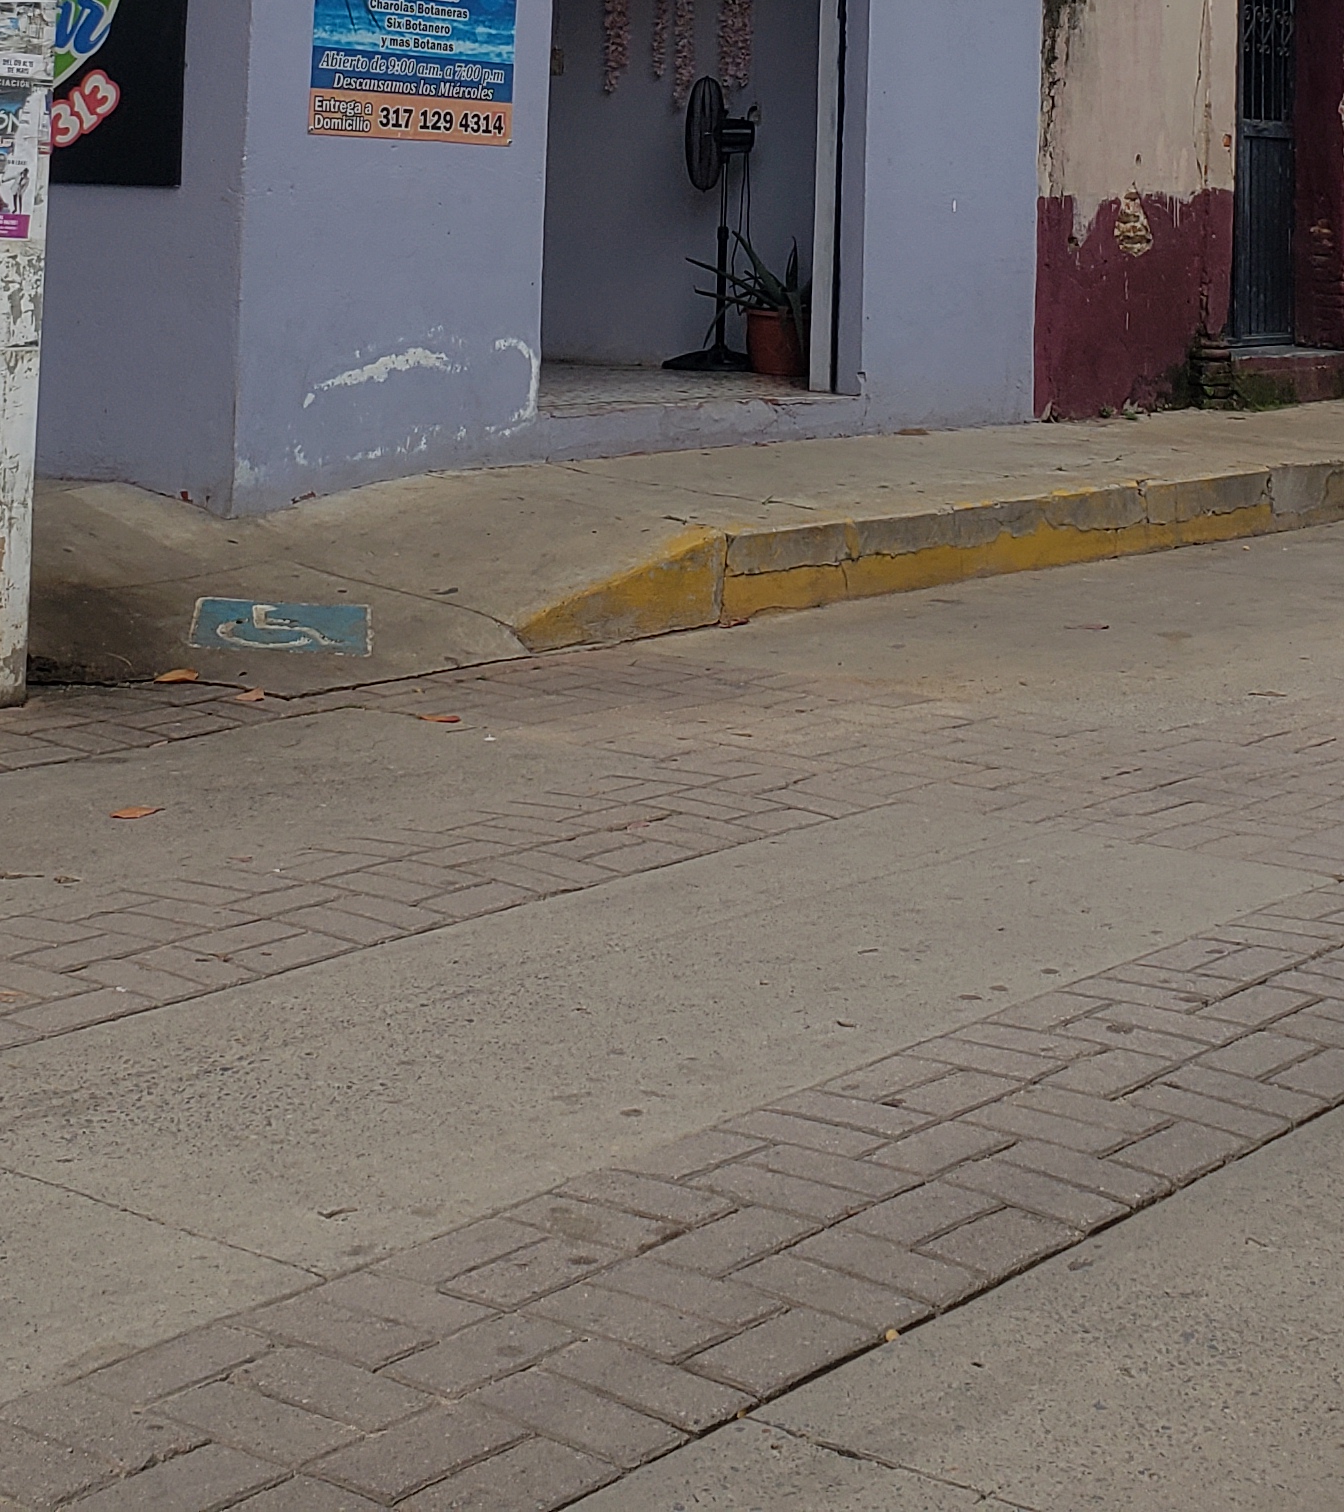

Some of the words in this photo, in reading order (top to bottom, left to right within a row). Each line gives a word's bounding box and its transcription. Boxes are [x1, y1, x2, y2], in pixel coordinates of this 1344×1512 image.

[417, 3, 468, 19] Botaneras
[386, 17, 403, 30] Six
[405, 19, 451, 35] Botanero
[380, 37, 388, 48] y
[389, 37, 411, 48] mas
[413, 37, 454, 53] Botanas
[320, 51, 369, 70] Abierto
[370, 56, 385, 72] de
[387, 58, 415, 74] 9:00
[417, 64, 443, 78] a.m.
[444, 67, 453, 78] a
[455, 63, 480, 80] 7:00
[482, 69, 504, 86] p.m
[333, 73, 416, 95] Descansamos
[418, 80, 436, 96] los
[438, 82, 494, 101] Miércoles
[314, 97, 362, 116] Entrega
[364, 102, 373, 115] a
[314, 114, 371, 132] Domicilio
[378, 105, 414, 130] 317
[419, 108, 454, 133] 129
[458, 111, 505, 137] 4314
